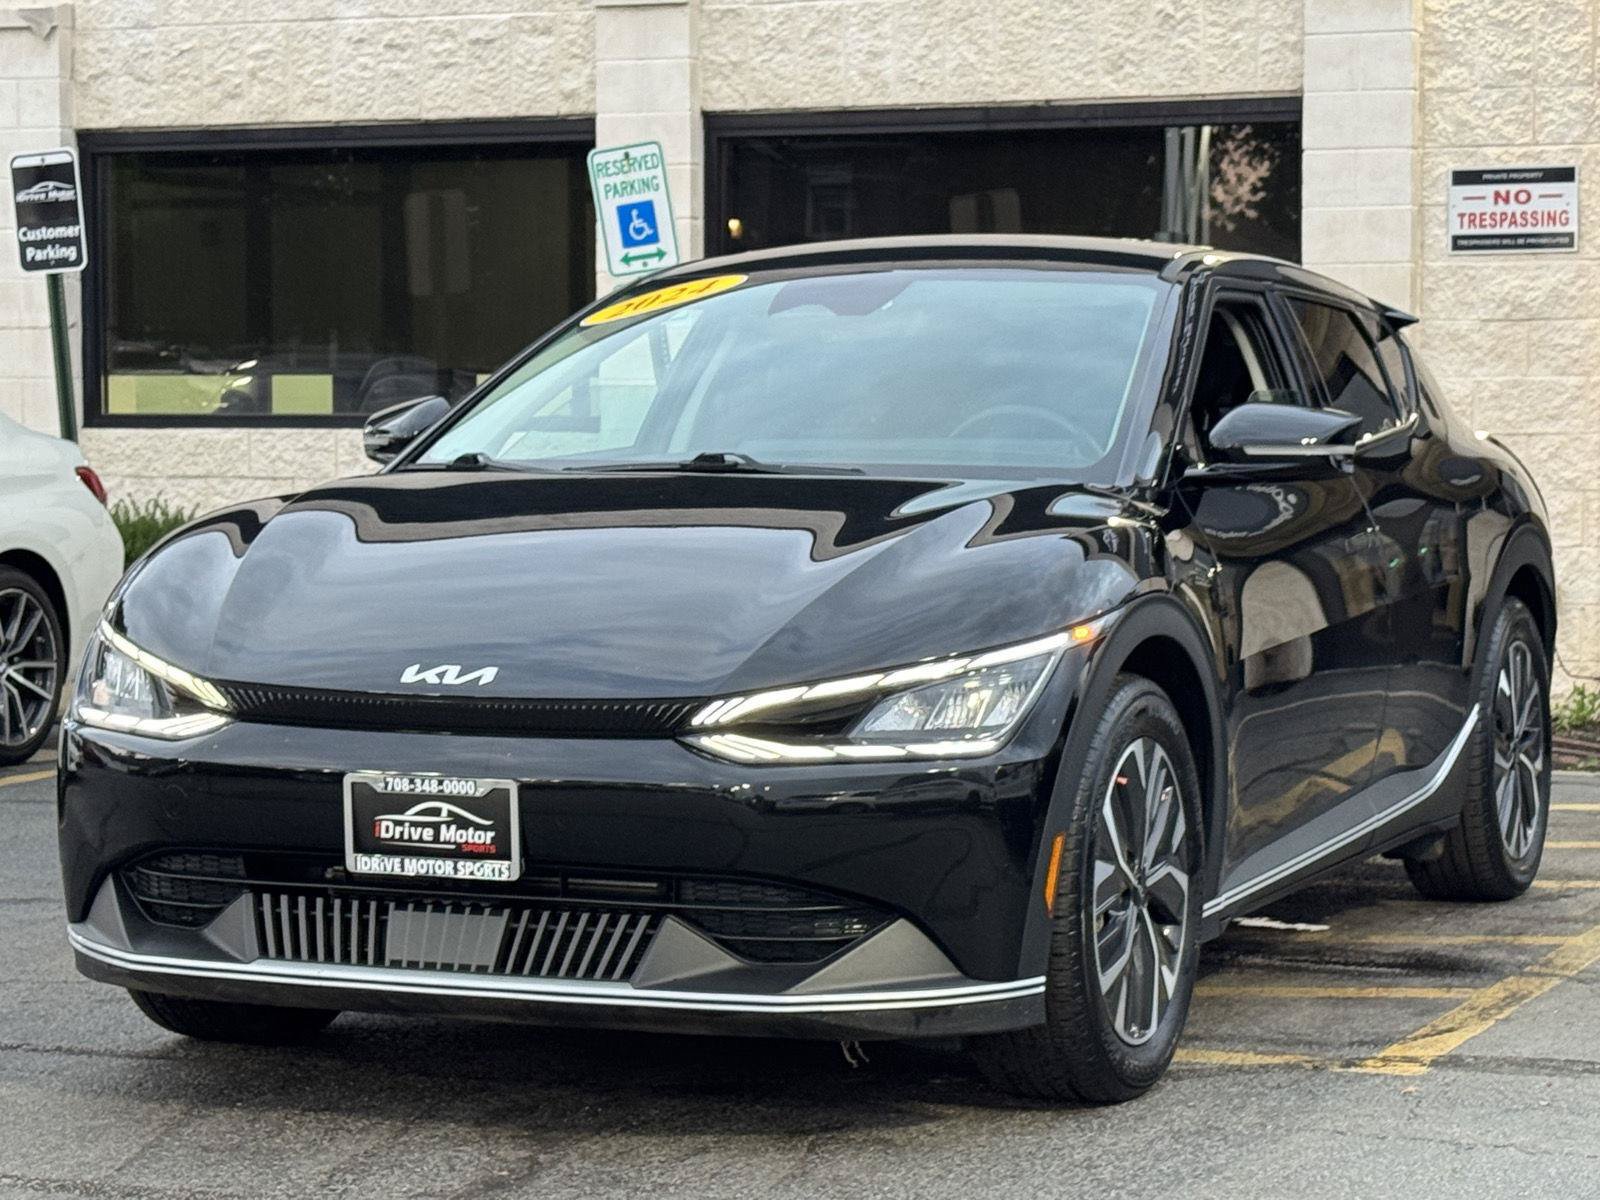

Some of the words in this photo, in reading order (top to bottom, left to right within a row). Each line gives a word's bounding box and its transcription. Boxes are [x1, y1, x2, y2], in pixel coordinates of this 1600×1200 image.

[595, 153, 660, 178] RESERVED
[604, 176, 660, 199] PARKING
[1493, 189, 1532, 205] NO
[1457, 210, 1570, 230] TRESPASSING
[19, 225, 80, 242] Customer
[25, 244, 78, 262] Parking
[606, 279, 719, 319] 2024
[385, 777, 476, 795] 708-348-0000
[373, 820, 434, 841] iDrive
[440, 824, 495, 844] Motor
[461, 843, 496, 853] SPORTS
[404, 859, 454, 876] MOTOR
[457, 860, 510, 879] SPORTS
